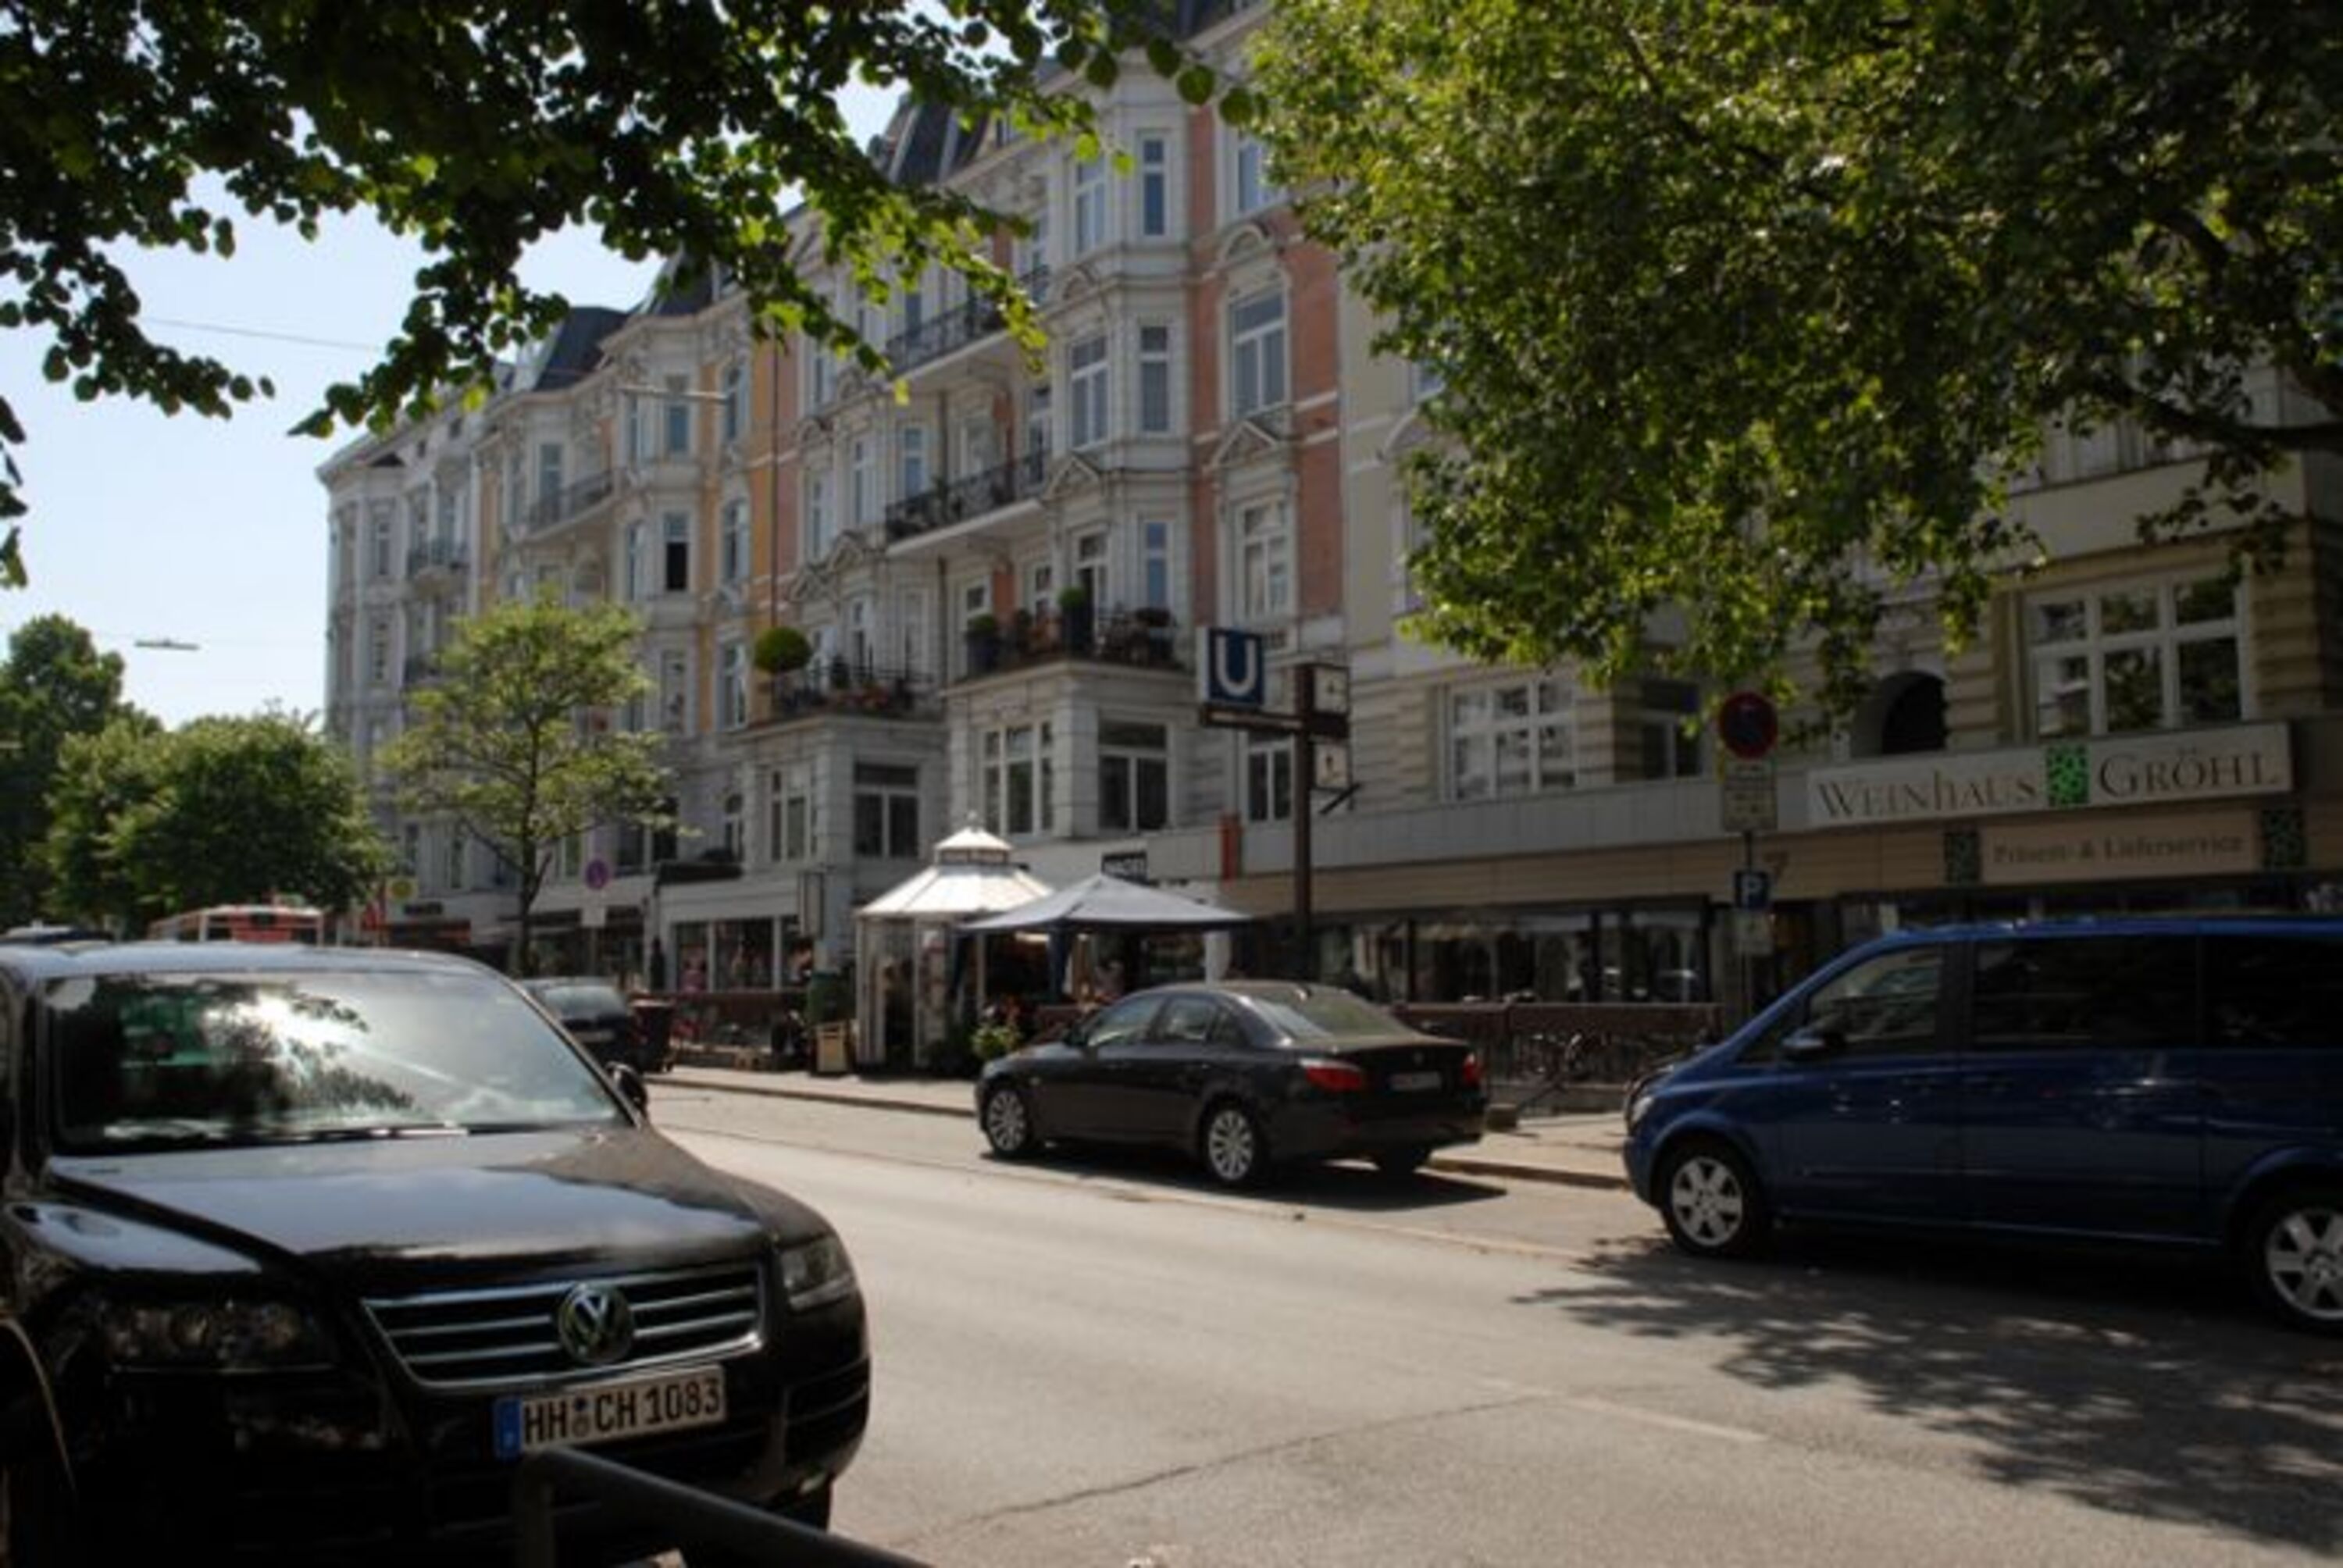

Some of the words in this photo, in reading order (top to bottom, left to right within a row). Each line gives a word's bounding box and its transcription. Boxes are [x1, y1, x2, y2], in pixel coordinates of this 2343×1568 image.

[1215, 636, 1257, 696] U
[2099, 747, 2280, 796] GRÖHL
[1741, 875, 1762, 908] P
[525, 1400, 567, 1443] HH
[595, 1391, 636, 1432] CH
[645, 1377, 720, 1424] 1083
